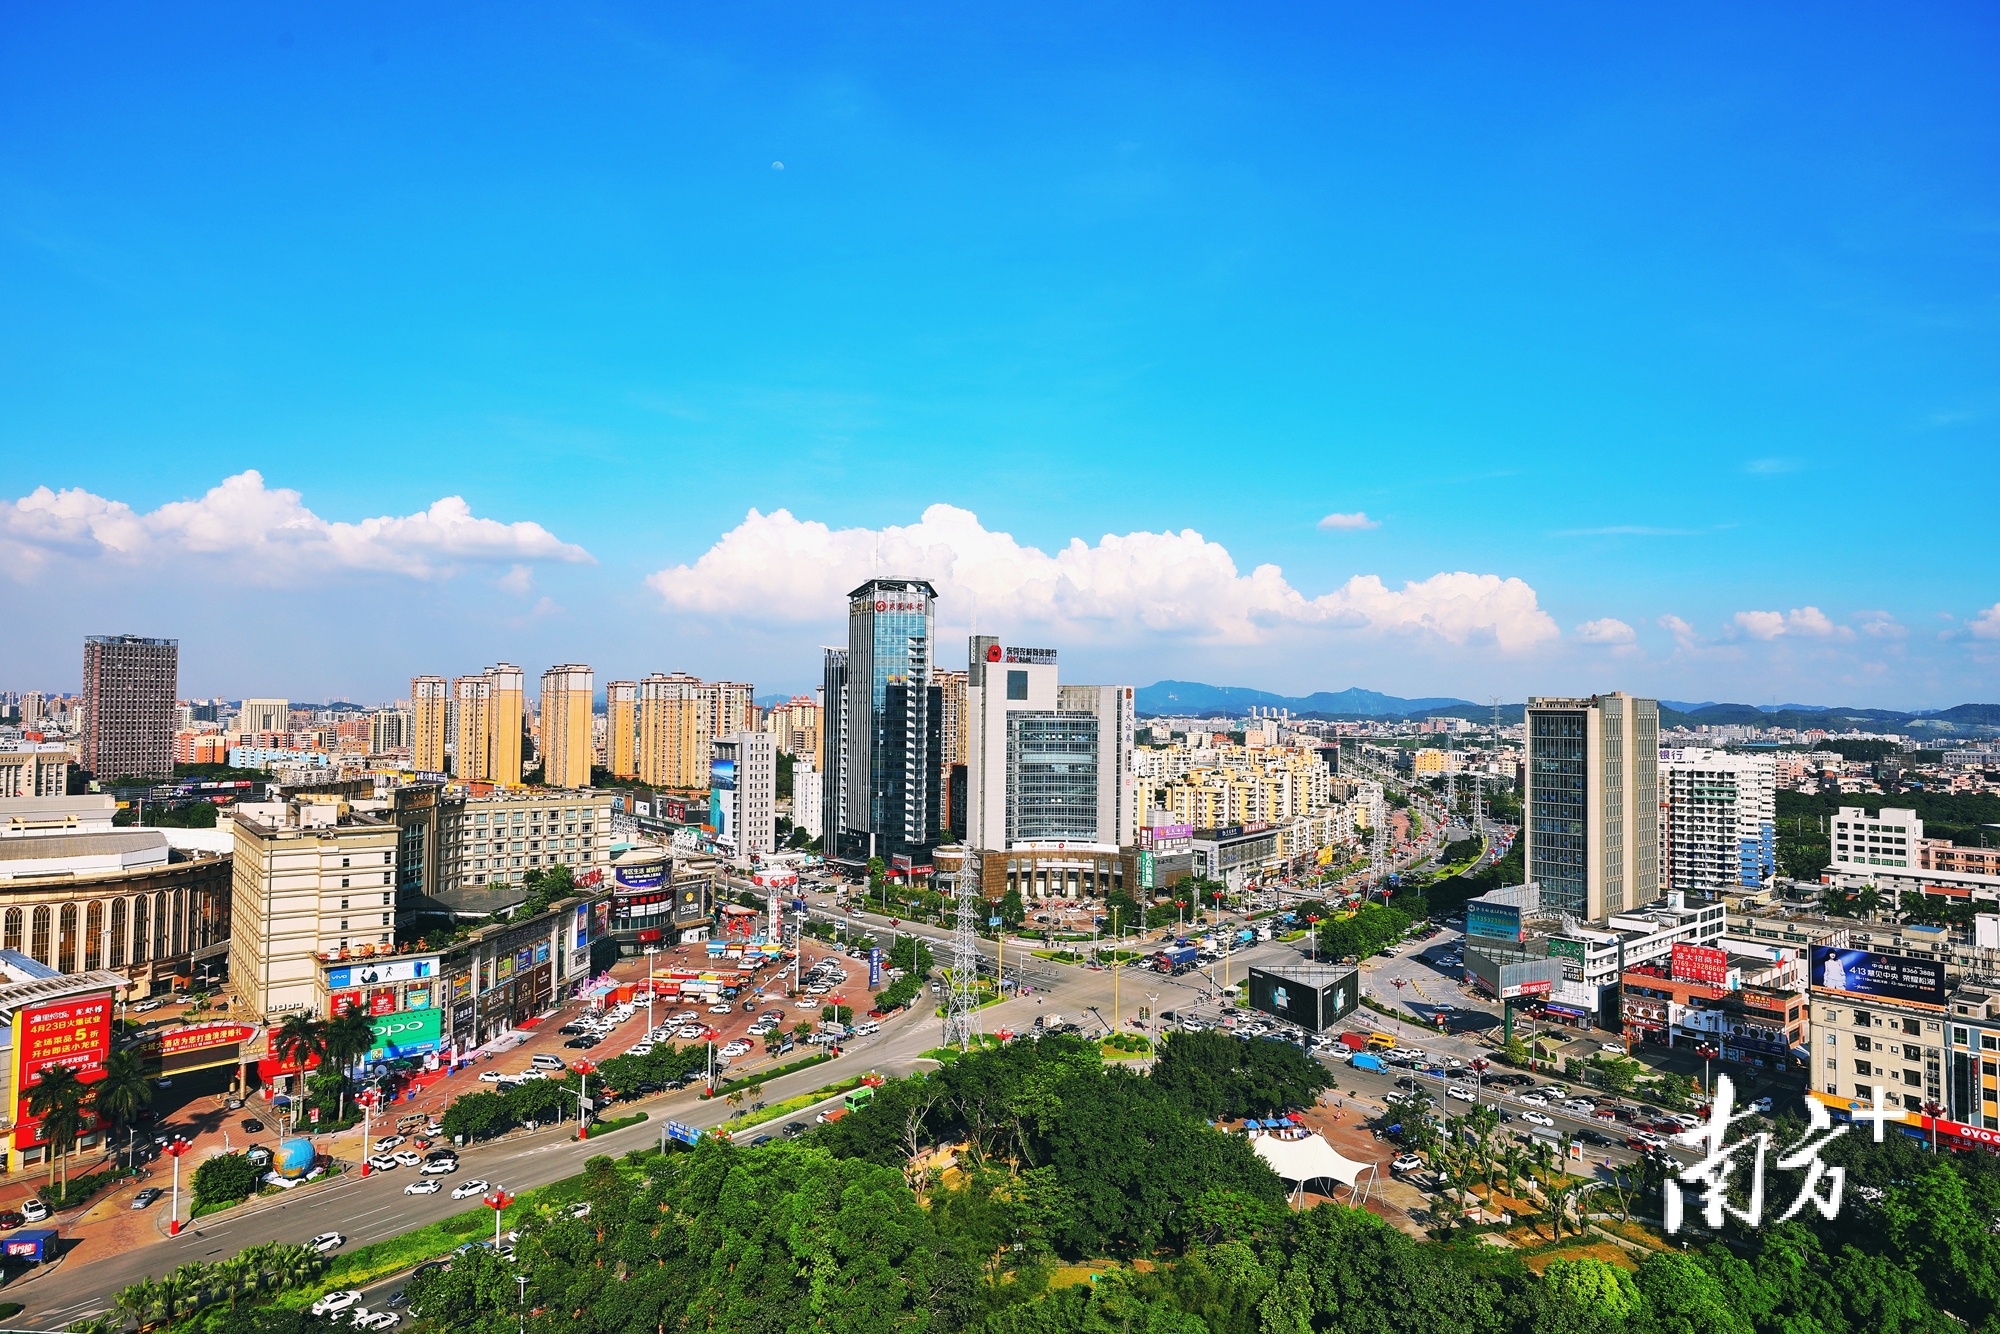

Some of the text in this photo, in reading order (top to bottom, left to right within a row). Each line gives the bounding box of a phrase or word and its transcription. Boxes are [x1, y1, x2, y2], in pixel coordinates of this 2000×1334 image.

[1659, 750, 1683, 760] 银行
[1676, 952, 1722, 965] 盛大招商中
[30, 1016, 101, 1033] 4月23日火爆试业
[33, 1028, 99, 1048] 全场菜品 5 折
[32, 1040, 100, 1058] 开台即送小龙虾
[1960, 1127, 1991, 1140] OYO
